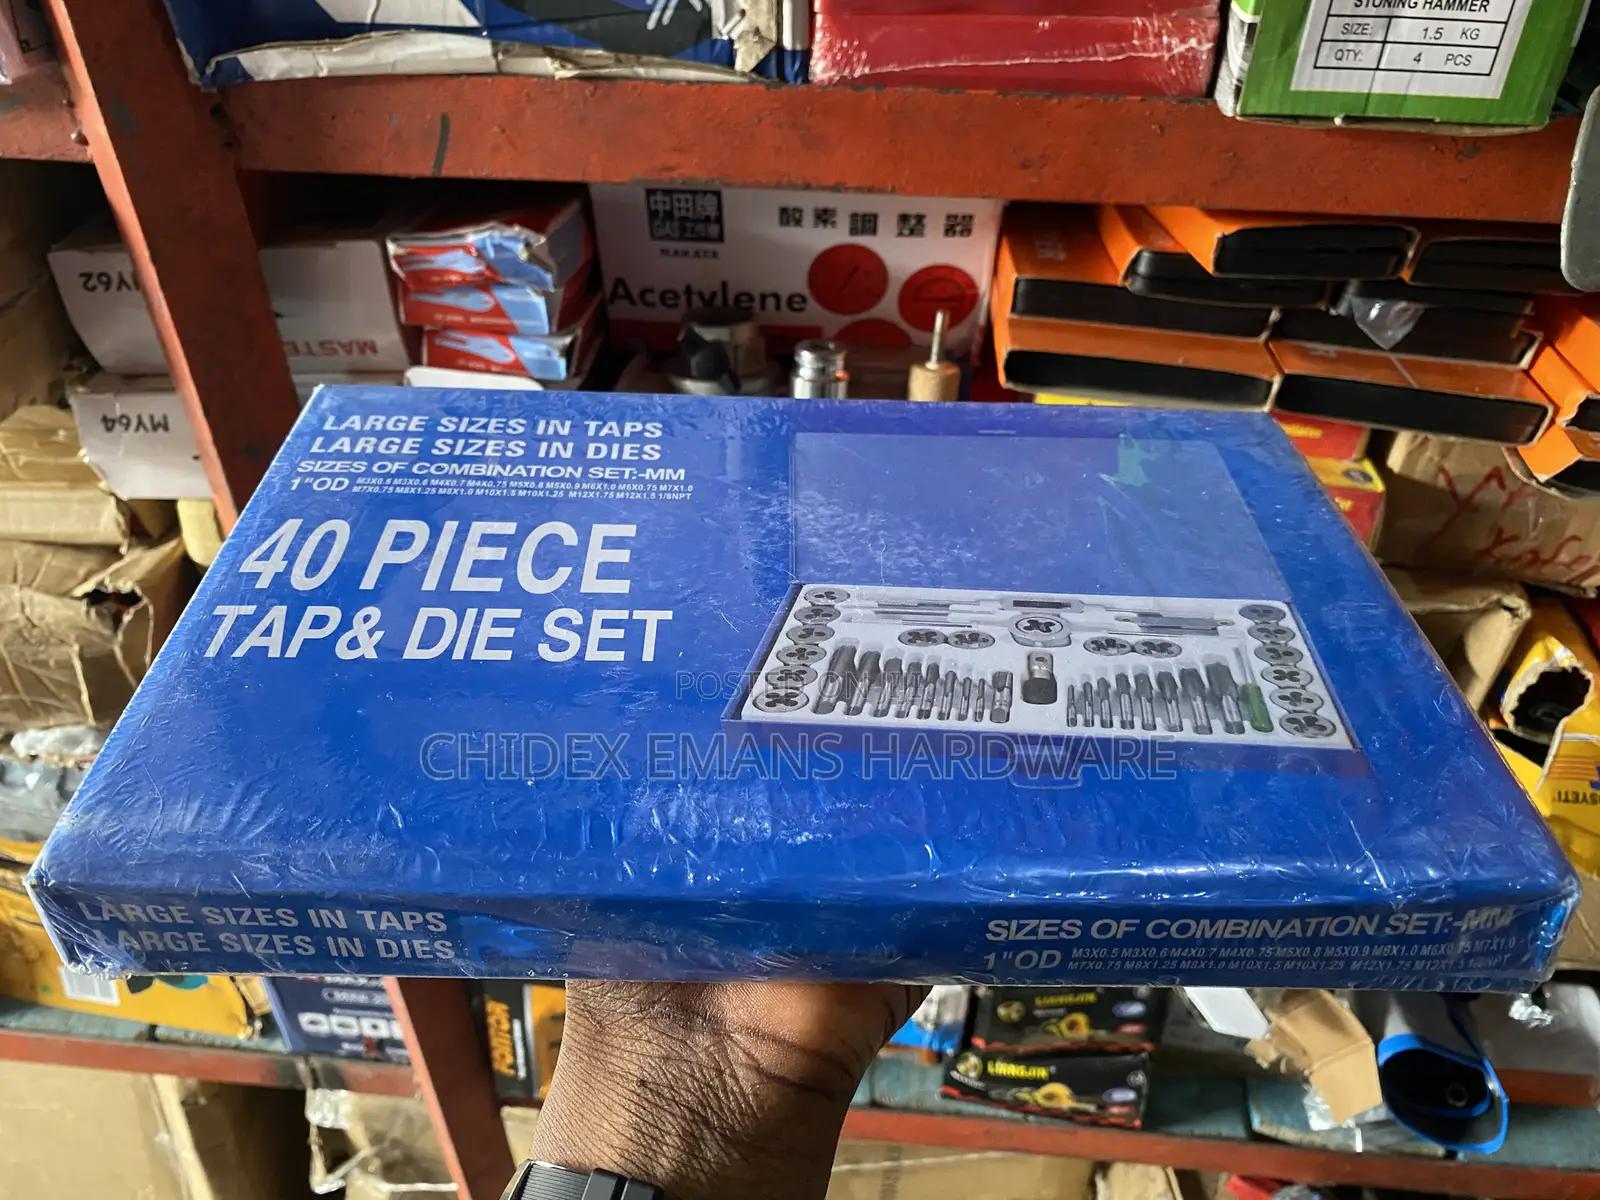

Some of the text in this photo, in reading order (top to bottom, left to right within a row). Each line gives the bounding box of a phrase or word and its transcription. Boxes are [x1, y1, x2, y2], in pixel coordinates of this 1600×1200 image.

[1354, 0, 1490, 13] STONING HAMMER
[1341, 23, 1480, 40] SIZE: 1.5 KG
[1334, 49, 1472, 66] QTY: 4 PCS
[608, 276, 809, 314] Acetylene
[101, 413, 170, 433] MY64
[323, 415, 663, 439] LARGE SIZES IN TAPS
[310, 436, 662, 461] LARGE SIZES IN DIES
[297, 461, 368, 474] SIZES
[372, 461, 409, 474] OF
[412, 462, 583, 479] COMBINATION
[352, 486, 692, 500] M7X0.75 M8X1.25 M8X1.0 M10X1.5 M10X1.25 M12X1.75 M12X1.5 1/8NPT
[356, 477, 693, 492] M3X0.5 M3X0.6 M4X0.7 M4X0.75 M5X0.8 M5X0.9 M6X1.0 M6X0.75 M7X1.0
[238, 518, 637, 595] 40 PIECE
[204, 604, 673, 662] TAP& DIE SET
[78, 901, 448, 932] LARGE SIZES IN TAPS
[985, 918, 1083, 941] SIZES
[1090, 919, 1141, 940] OF
[1146, 915, 1380, 940] COMBINATION
[221, 933, 316, 956] SIZES
[326, 935, 365, 958] IN
[377, 938, 456, 960] DIES
[1071, 947, 1118, 959] M3X0.5
[1121, 947, 1167, 959] M3X0.6
[1169, 946, 1217, 958] M4X0.7
[1323, 945, 1369, 957] M5X0.9
[1372, 944, 1417, 957] M6X1.0
[1068, 960, 1122, 971] M7X0.75
[1124, 960, 1177, 970] M8X1.25
[1179, 960, 1226, 970] M8X1.0
[1228, 960, 1281, 971] M10X1.5
